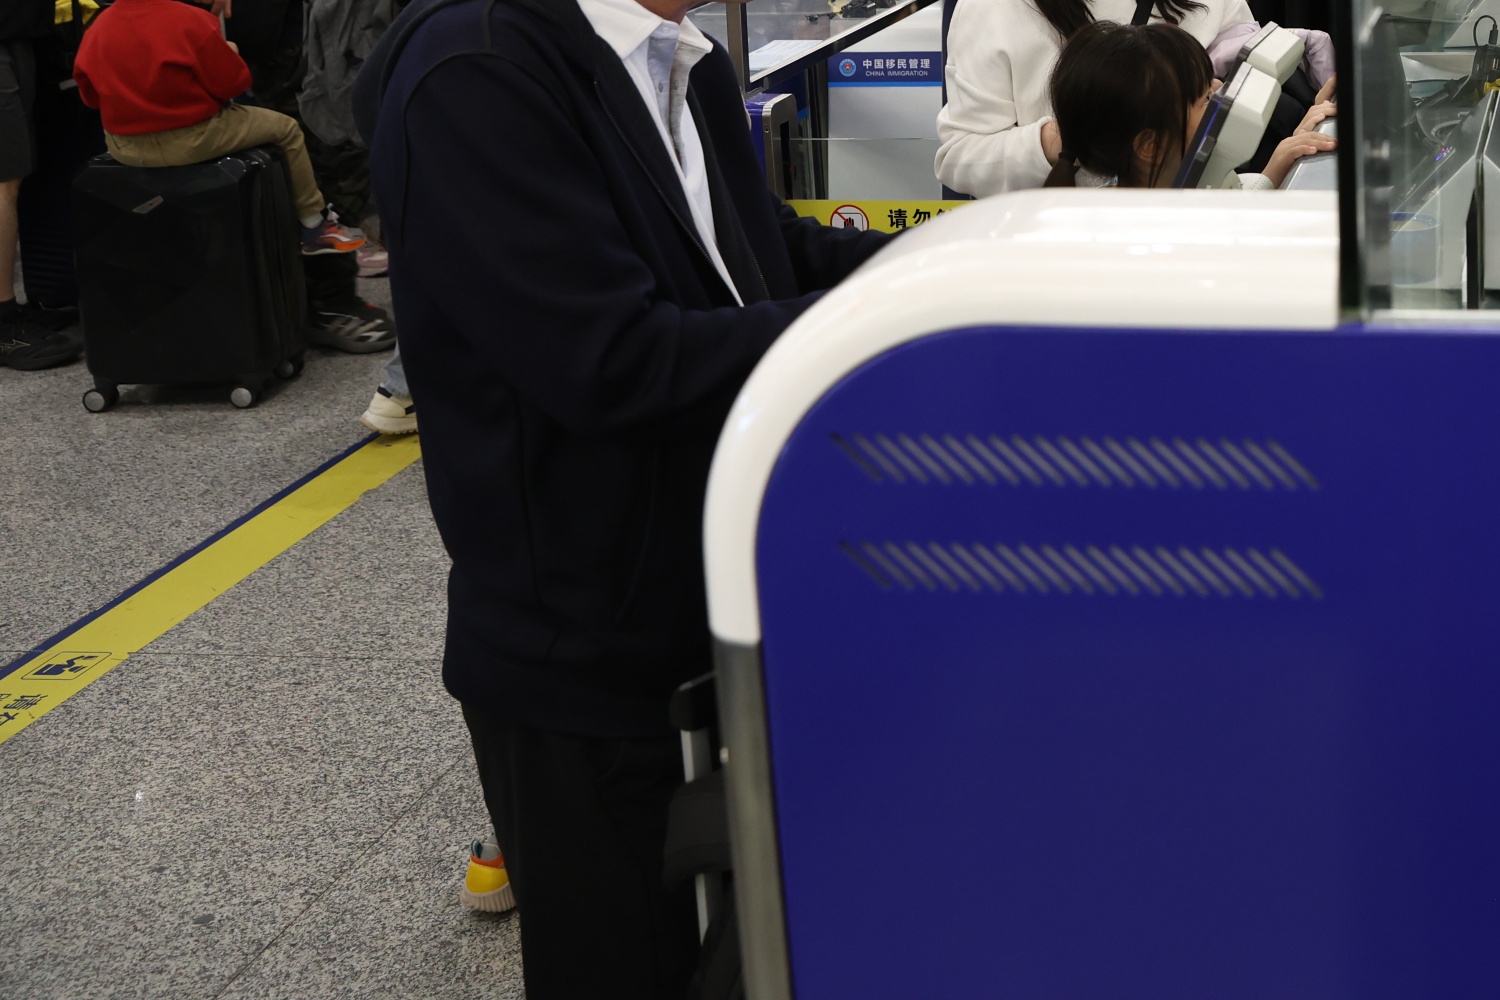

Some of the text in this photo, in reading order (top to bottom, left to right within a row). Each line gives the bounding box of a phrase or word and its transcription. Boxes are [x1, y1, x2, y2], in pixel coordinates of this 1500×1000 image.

[862, 58, 931, 69] 中国移民管理
[887, 208, 952, 229] 请勿
